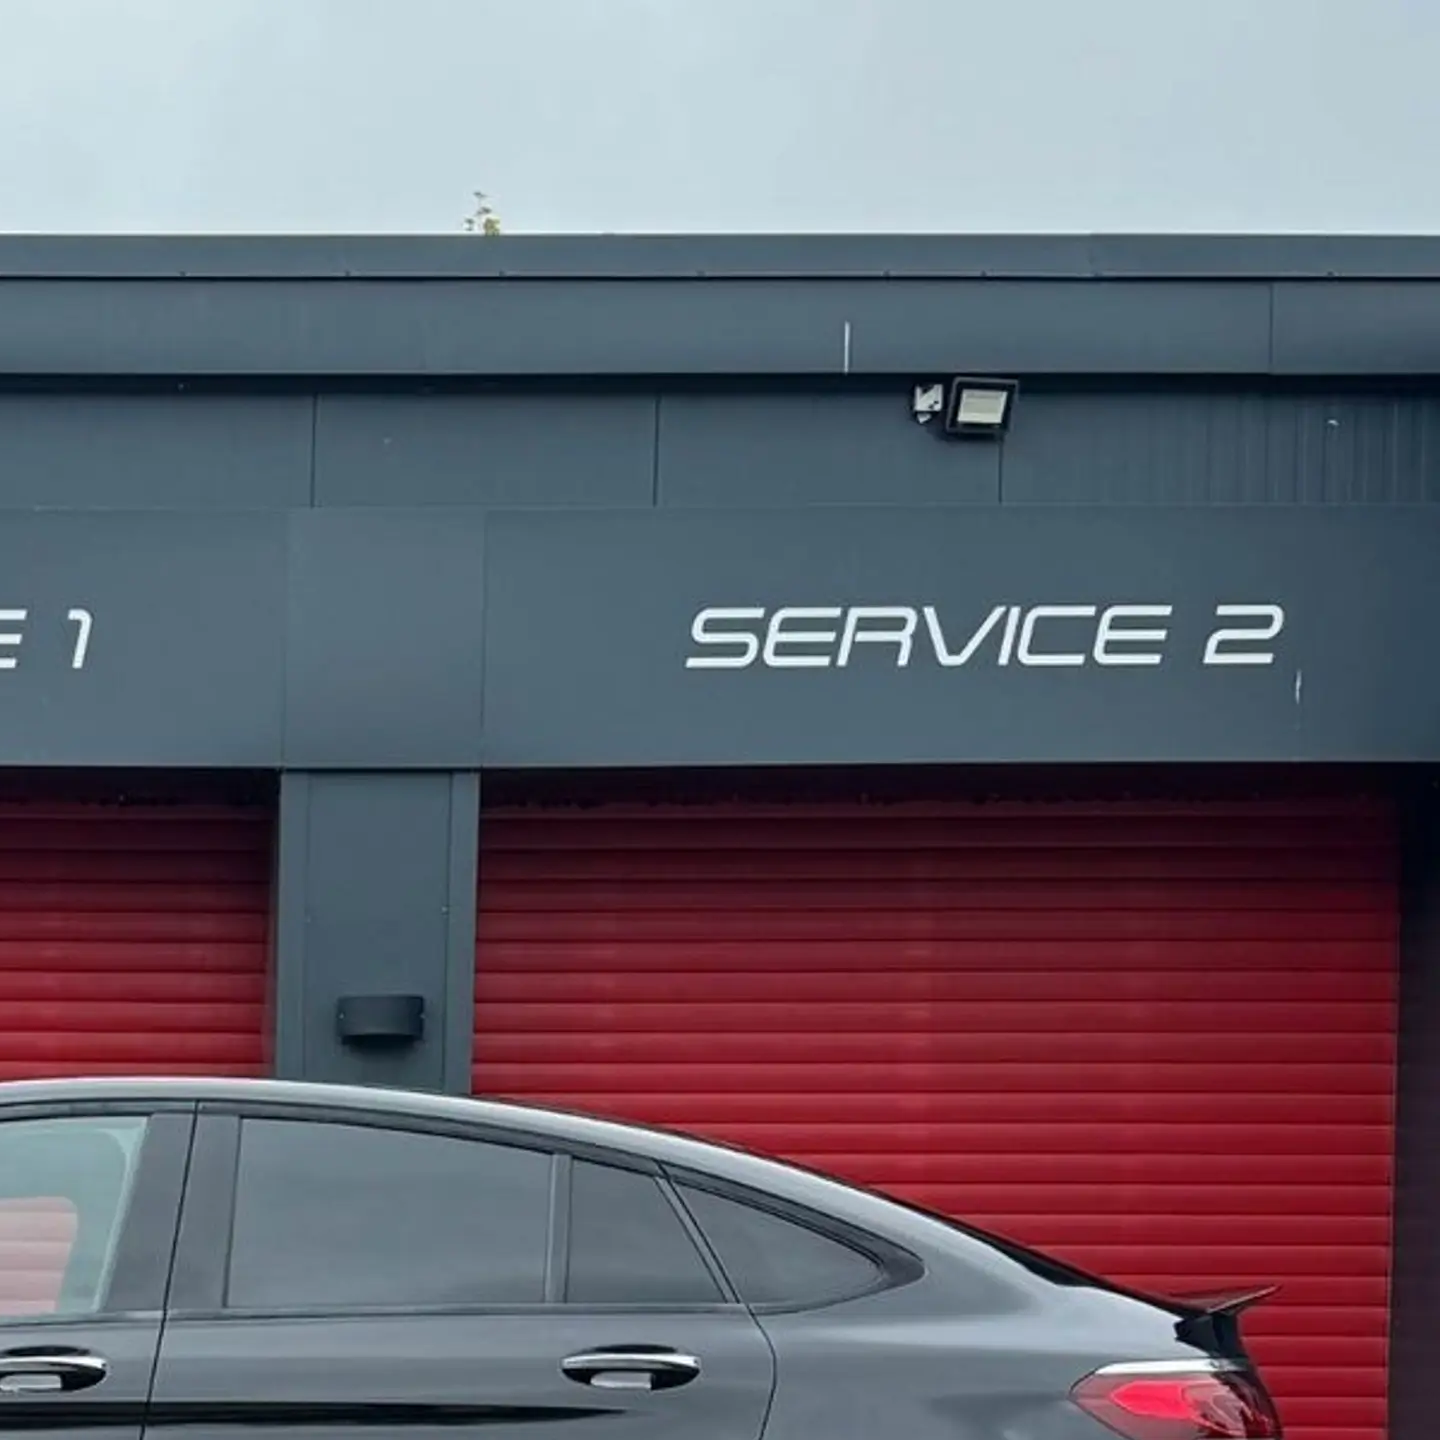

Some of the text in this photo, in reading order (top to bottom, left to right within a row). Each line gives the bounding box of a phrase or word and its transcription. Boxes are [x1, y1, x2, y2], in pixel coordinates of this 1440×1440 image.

[68, 609, 92, 669] 1
[685, 604, 1284, 667] SERVICE 2
